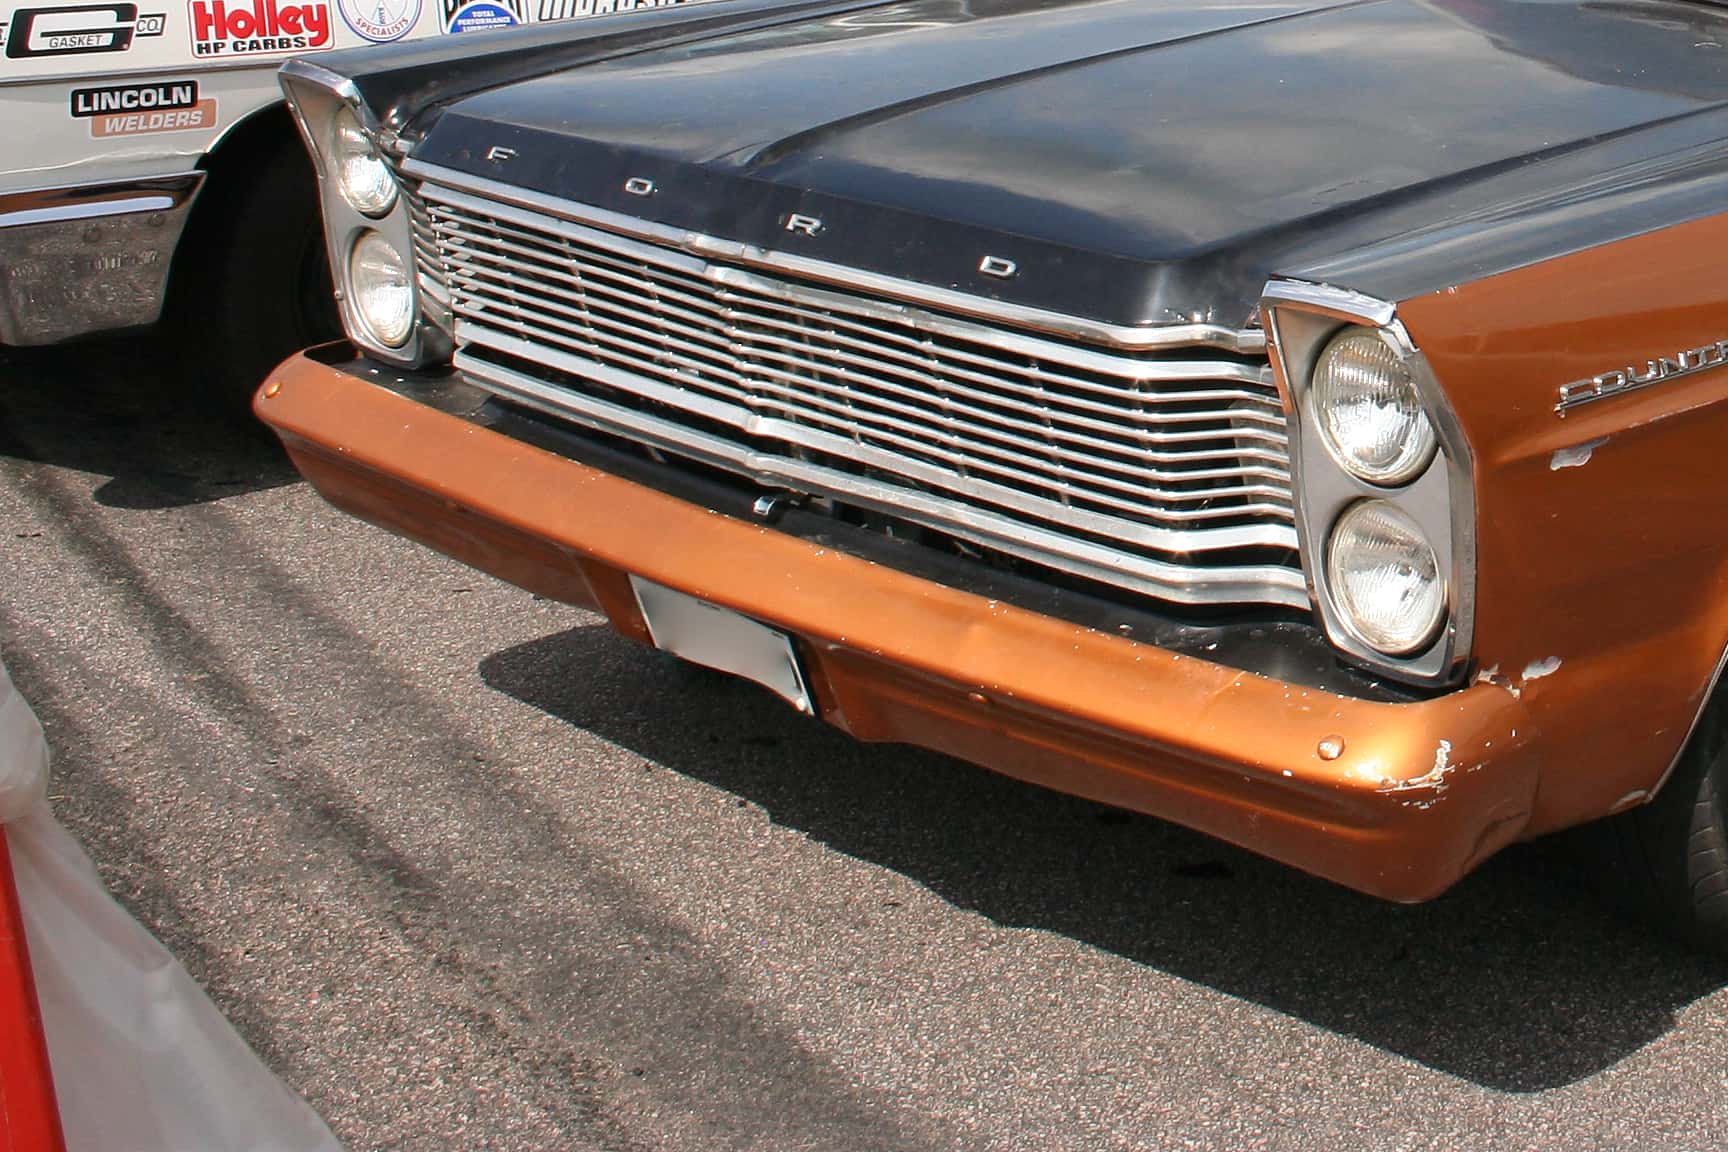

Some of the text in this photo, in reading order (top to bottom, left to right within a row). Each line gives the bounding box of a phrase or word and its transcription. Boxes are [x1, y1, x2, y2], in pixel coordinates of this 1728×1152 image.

[355, 16, 409, 36] SPECIALISTS
[49, 34, 103, 49] GASKET
[196, 36, 308, 54] HP CARBS
[77, 85, 193, 113] LINCOLN
[104, 109, 204, 134] WELDERS
[488, 144, 1016, 280] FORD
